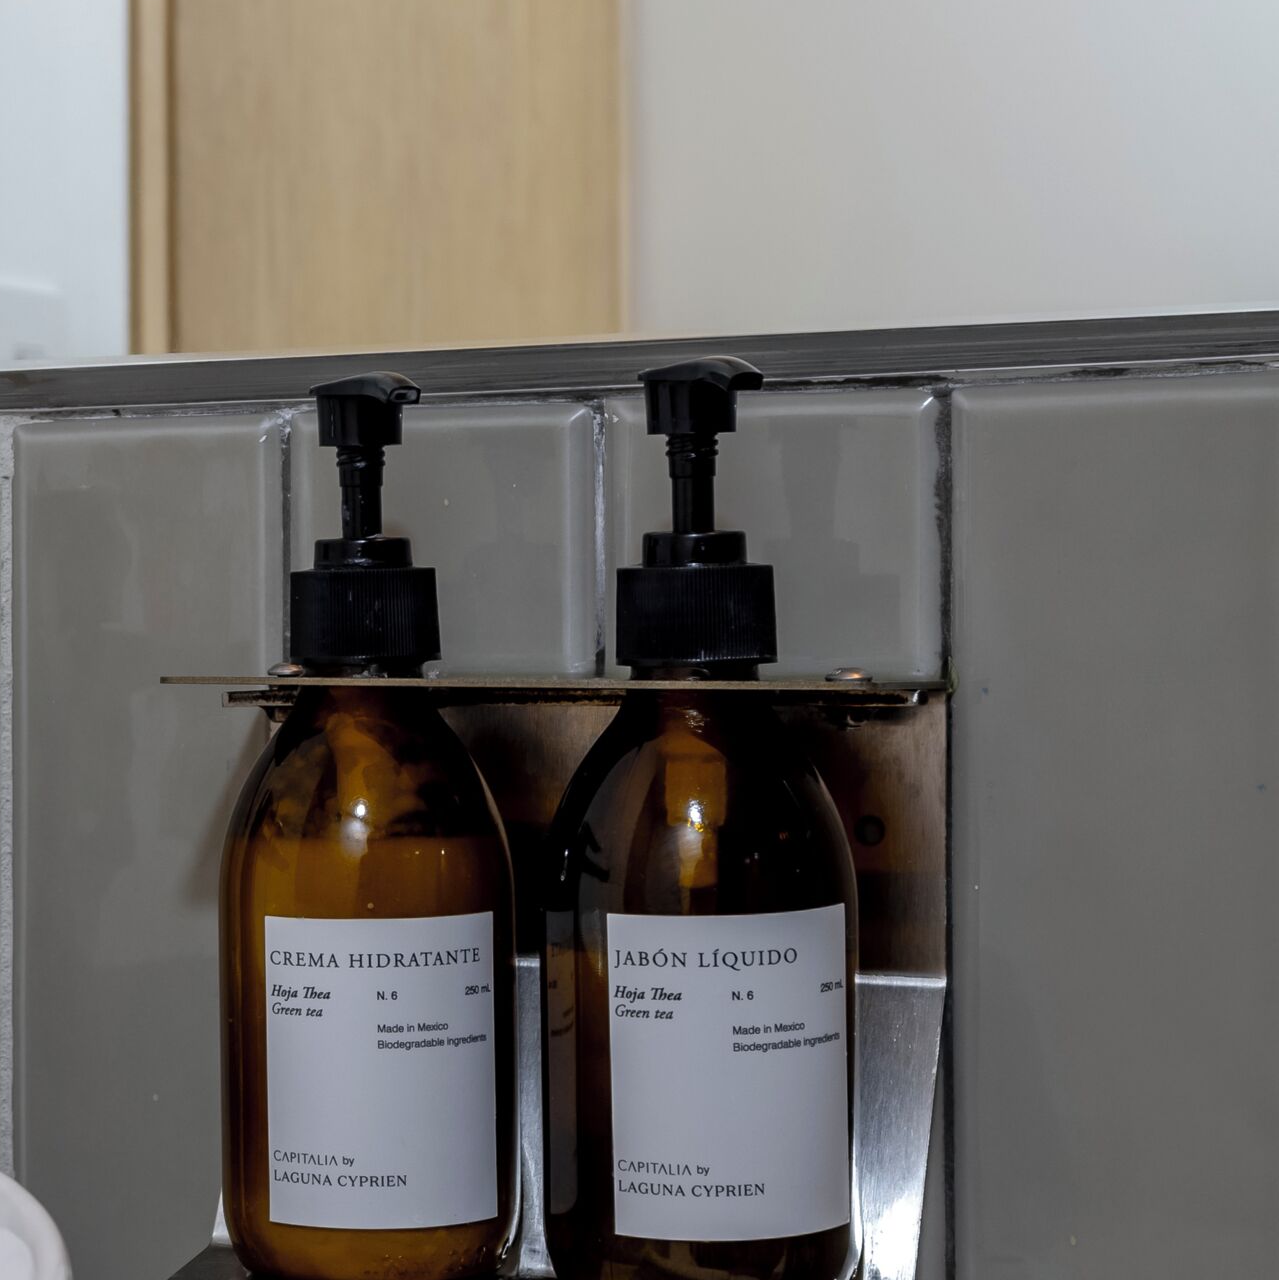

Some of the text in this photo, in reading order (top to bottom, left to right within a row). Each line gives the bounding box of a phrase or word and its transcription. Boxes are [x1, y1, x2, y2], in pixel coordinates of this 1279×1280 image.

[270, 947, 481, 969] CREMA HIDRATANTE
[614, 947, 798, 971] JABÓN LÍQUIDO
[271, 984, 331, 1002] Hoja Thea
[377, 991, 398, 1001] N. 6
[465, 986, 480, 996] 250
[613, 985, 682, 1004] Hoja Thea
[732, 991, 754, 1001] N. 6
[820, 983, 834, 993] 250
[272, 1002, 323, 1018] Green tea
[615, 1004, 674, 1020] Green tea
[377, 1021, 449, 1034] Made in Mexico
[732, 1021, 805, 1036] Made in Mexico
[377, 1033, 487, 1051] Biodegradable ingredients
[732, 1031, 840, 1054] Biodegradable ingredients
[273, 1149, 355, 1167] CAPITALIA by
[618, 1159, 710, 1177] CAPITALIA by
[274, 1169, 407, 1188] LAGUNA CYPRIEN
[618, 1180, 766, 1198] LAGUNA CYPRIEN
